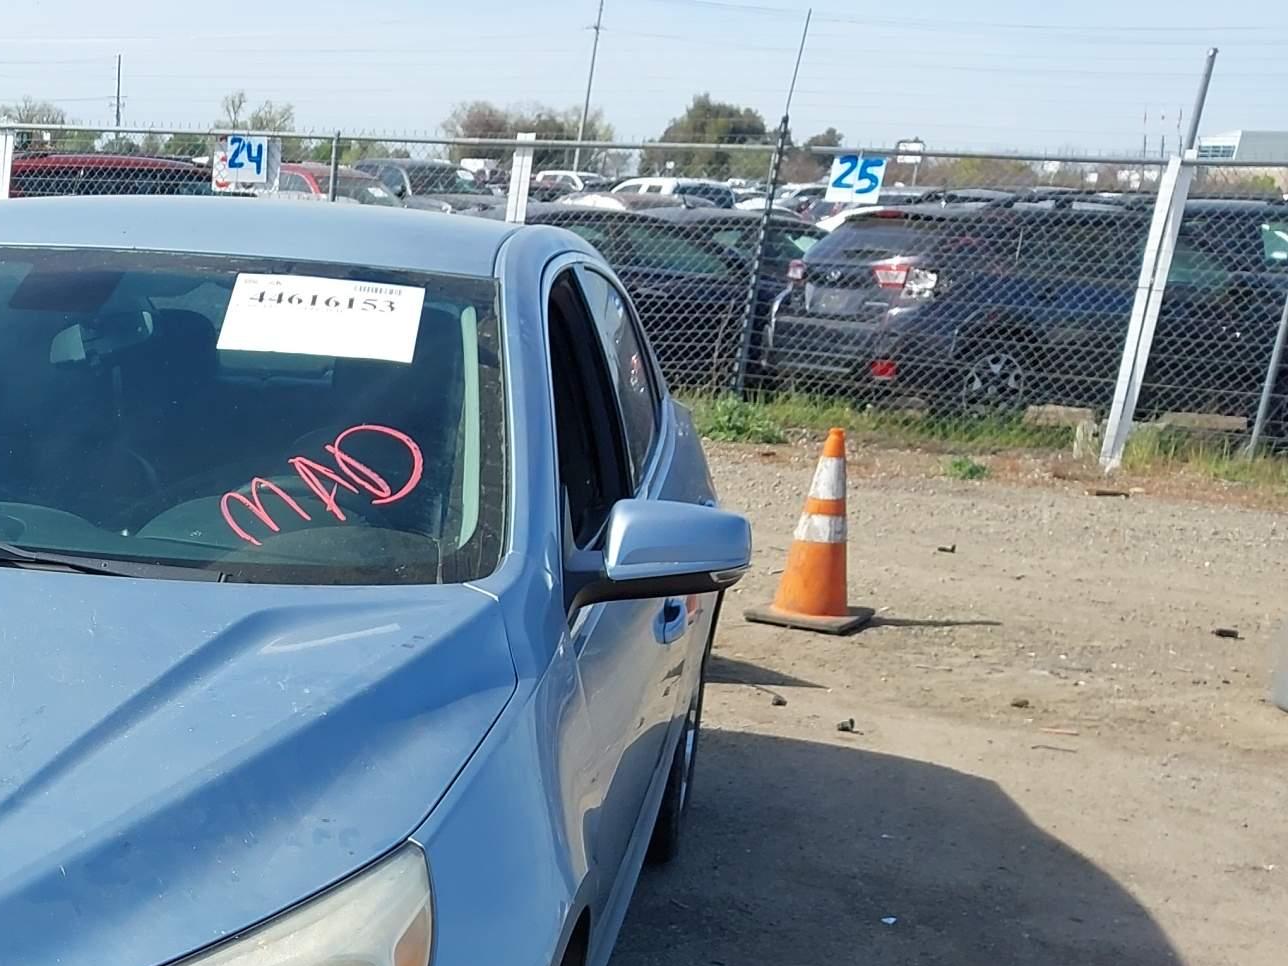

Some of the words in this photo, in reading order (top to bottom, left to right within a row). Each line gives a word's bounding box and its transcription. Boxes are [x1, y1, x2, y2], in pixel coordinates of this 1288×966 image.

[228, 137, 263, 175] 24
[832, 155, 884, 194] 25
[249, 290, 396, 313] 44616153
[220, 424, 424, 546] MAD
